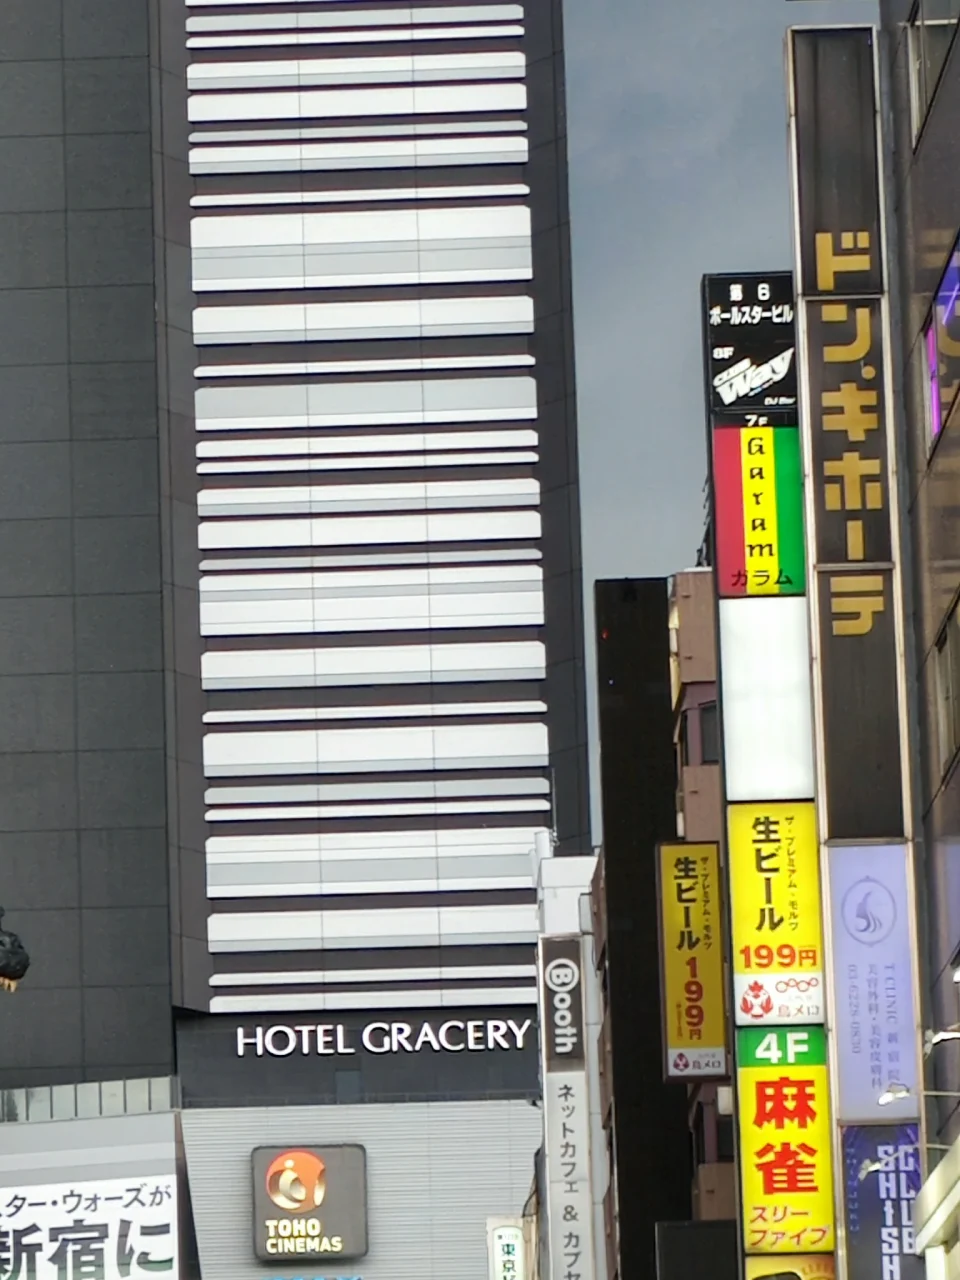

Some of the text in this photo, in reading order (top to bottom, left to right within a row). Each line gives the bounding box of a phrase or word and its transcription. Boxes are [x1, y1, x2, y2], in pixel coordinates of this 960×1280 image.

[731, 570, 793, 587] ガラム
[752, 816, 784, 932] 生ビール
[673, 856, 701, 952] 生ビール
[740, 944, 818, 969] 199円
[544, 957, 579, 1055] Booth
[684, 956, 705, 1041] 199円
[236, 1019, 533, 1057] HOTEL GRACERY
[755, 1033, 809, 1064] 4F
[753, 1077, 819, 1195] 麻雀
[265, 1219, 321, 1238] TOHO
[749, 1206, 810, 1225] スリー
[266, 1236, 343, 1255] CINEMAS
[749, 1226, 831, 1247] ファイブ
